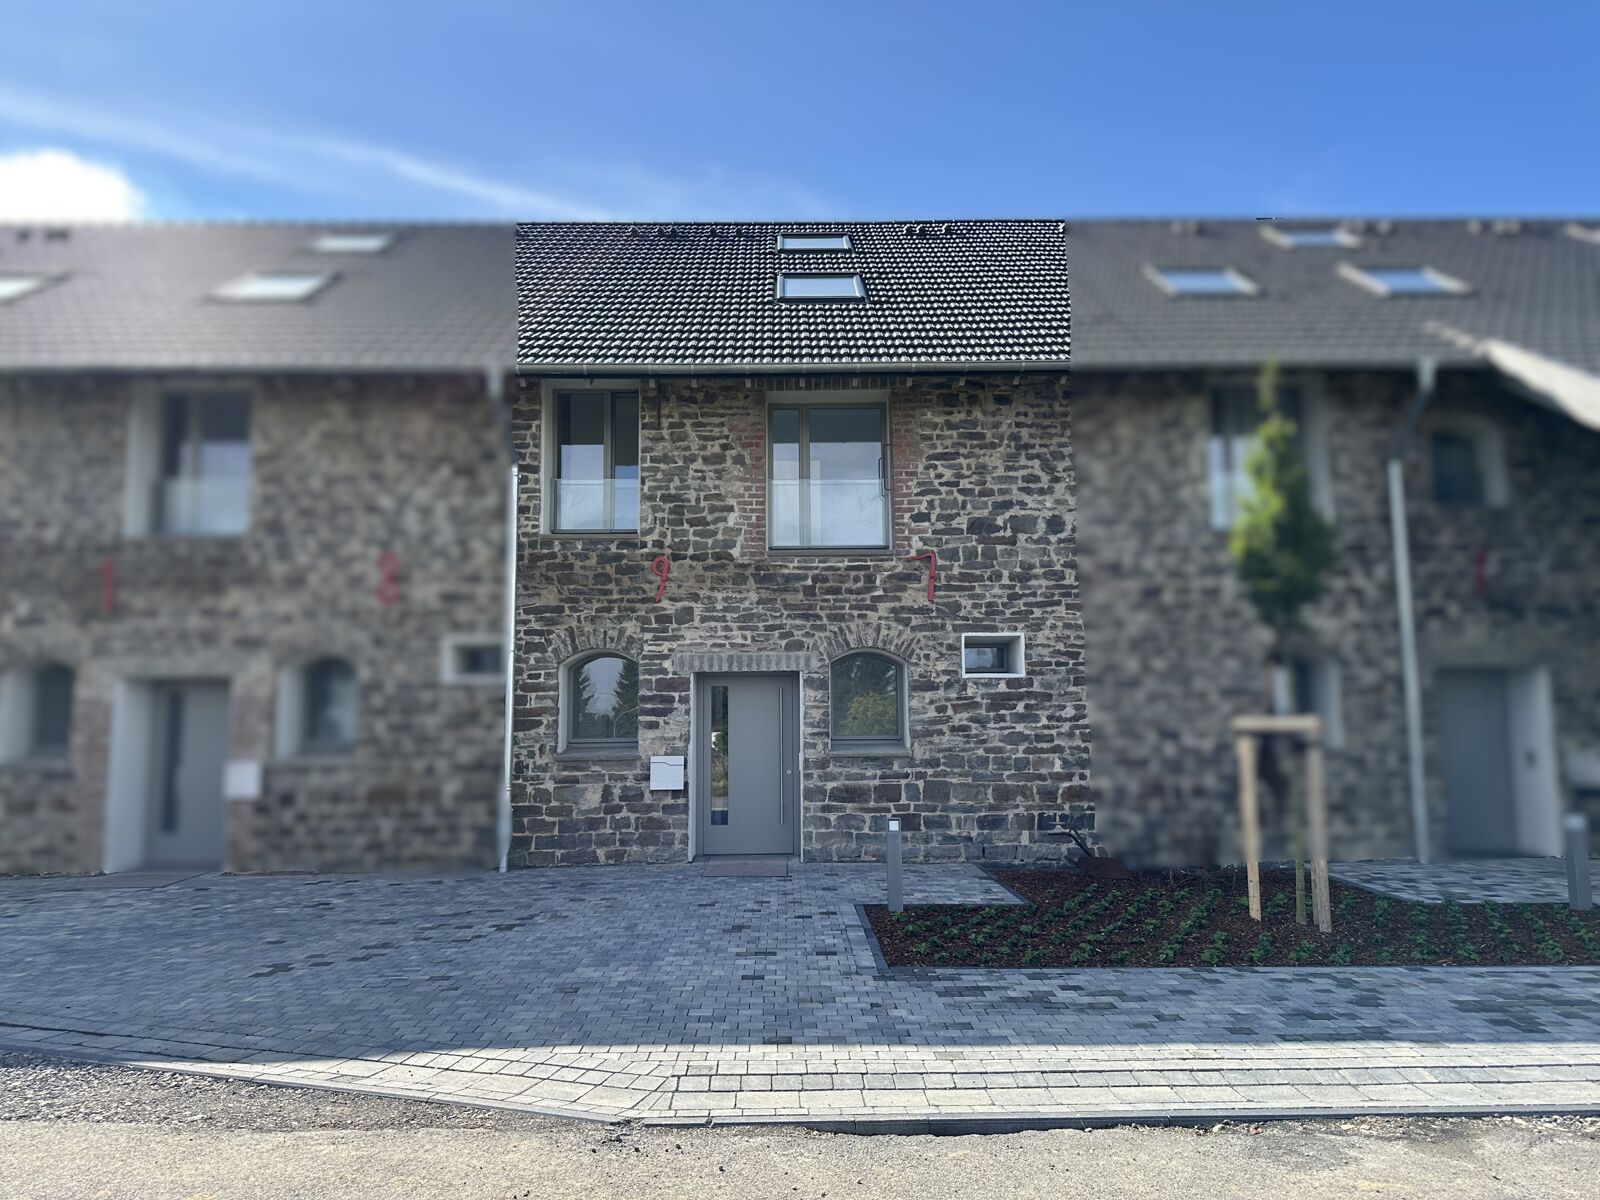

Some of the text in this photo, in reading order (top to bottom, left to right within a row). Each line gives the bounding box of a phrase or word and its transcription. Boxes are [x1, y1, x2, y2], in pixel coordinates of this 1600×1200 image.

[376, 551, 401, 605] 8
[652, 557, 670, 602] 9
[906, 552, 937, 601] 7
